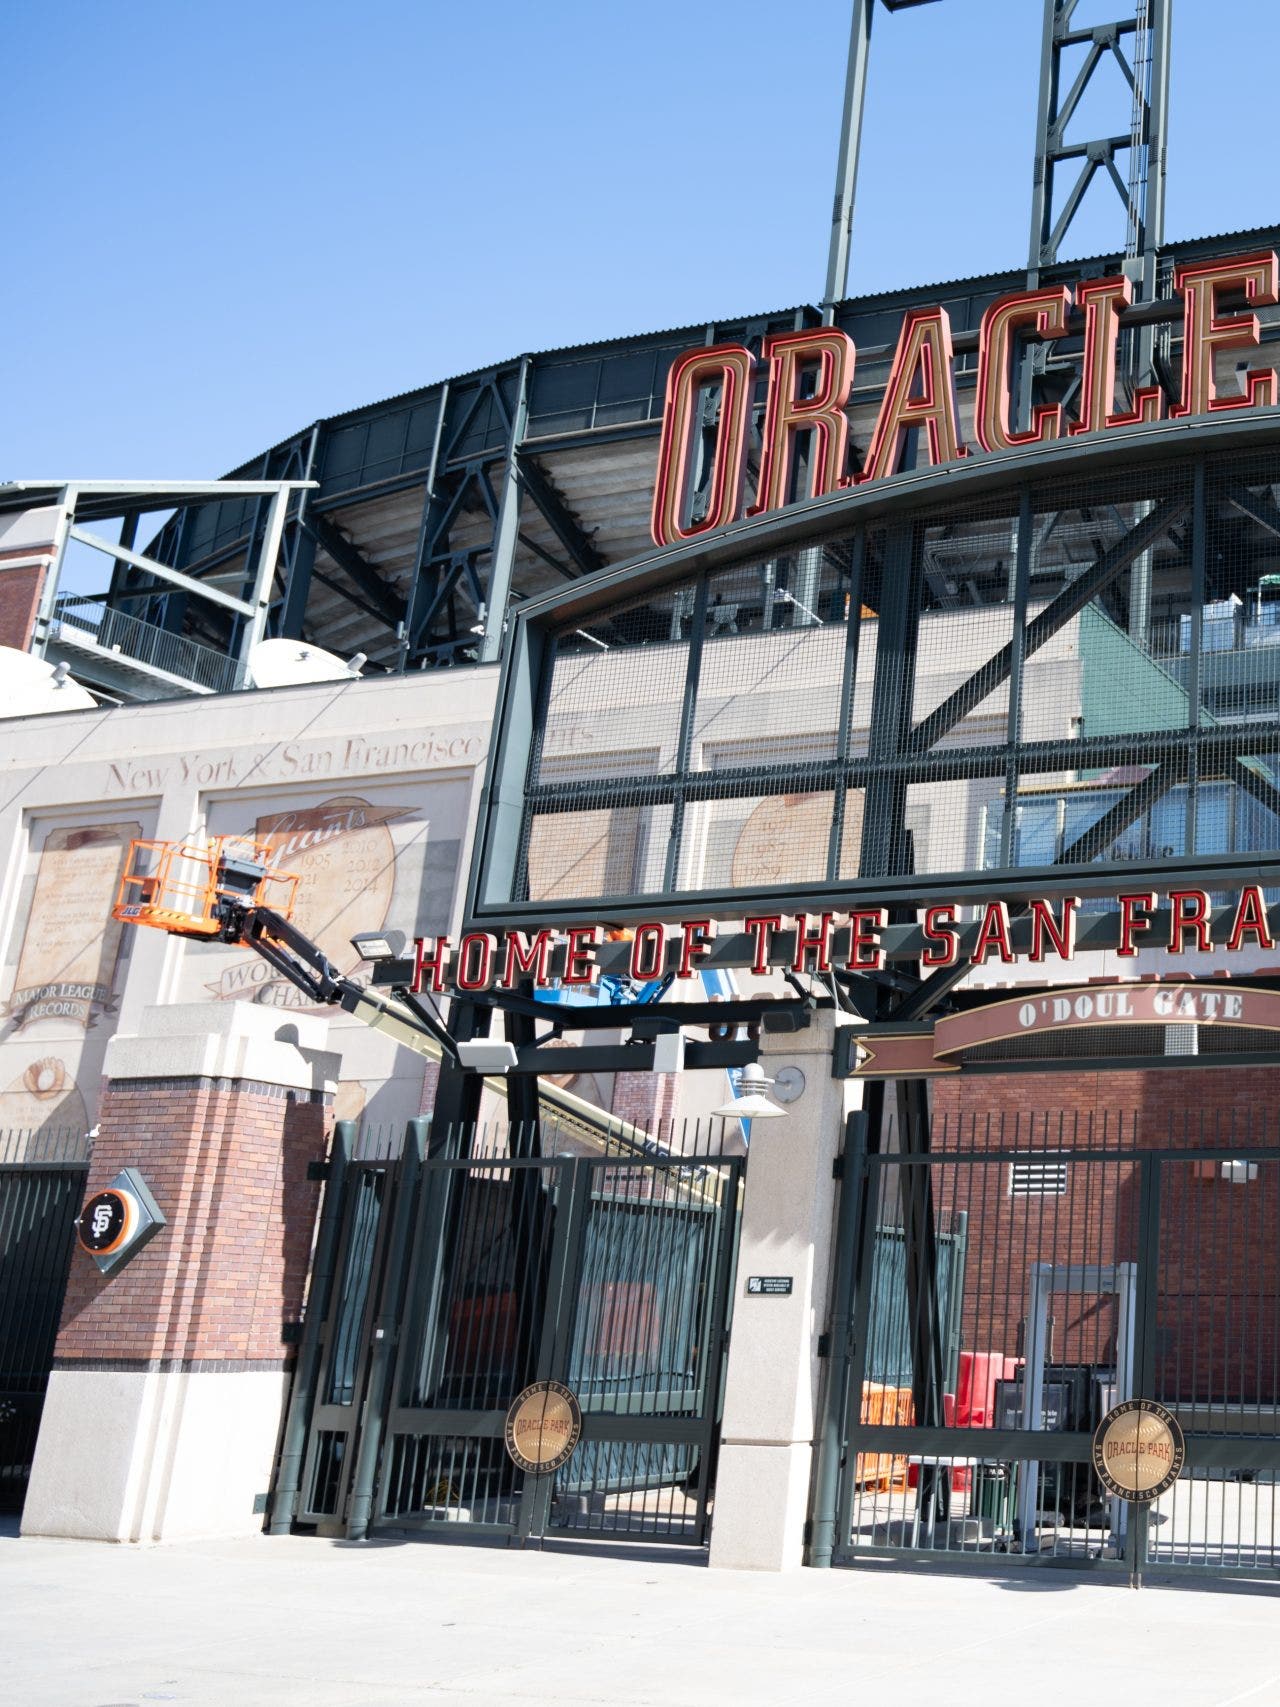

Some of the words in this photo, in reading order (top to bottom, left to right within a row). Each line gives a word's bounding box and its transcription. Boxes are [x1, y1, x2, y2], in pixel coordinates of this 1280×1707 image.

[651, 250, 1279, 547] ORACLE
[103, 763, 169, 794] New
[180, 756, 239, 786] York
[278, 743, 333, 777] San
[341, 733, 482, 771] Francisco
[122, 906, 140, 916] JLG
[410, 926, 603, 993] HOME
[630, 919, 718, 980] OF
[745, 908, 888, 975] THE
[921, 896, 1081, 967] SAN
[15, 983, 57, 1005] MAJOR
[60, 981, 107, 1001] LEAGUE
[30, 1001, 87, 1020] RECORDS
[1018, 992, 1134, 1028] O'DOUL
[1153, 991, 1244, 1020] GATE
[1107, 1402, 1134, 1422] HOME
[1140, 1402, 1152, 1410] OF
[1155, 1407, 1172, 1424] THE
[1095, 1444, 1103, 1467] SAN
[1162, 1447, 1182, 1488] GIANTS
[1107, 1441, 1145, 1461] ORACLE
[1148, 1442, 1170, 1463] PARK
